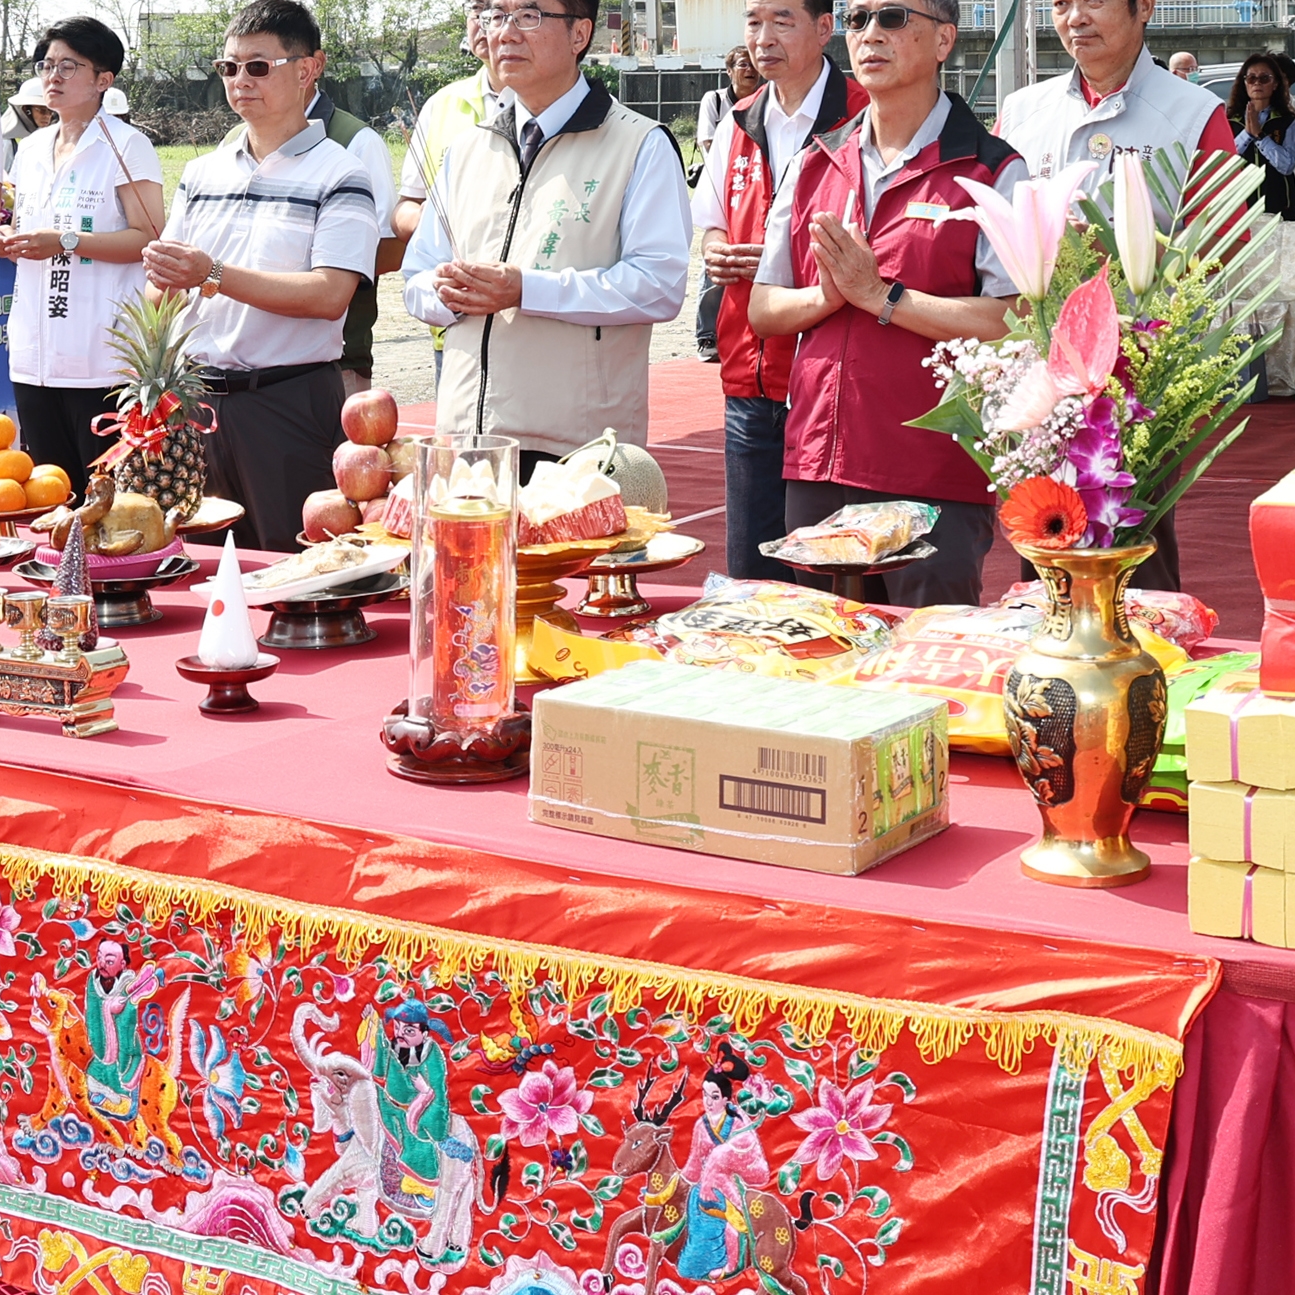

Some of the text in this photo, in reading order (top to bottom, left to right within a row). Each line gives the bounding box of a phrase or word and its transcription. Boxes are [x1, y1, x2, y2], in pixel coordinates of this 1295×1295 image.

[574, 178, 600, 224] 市長
[642, 751, 690, 796] 麥香
[858, 811, 868, 834] 2
